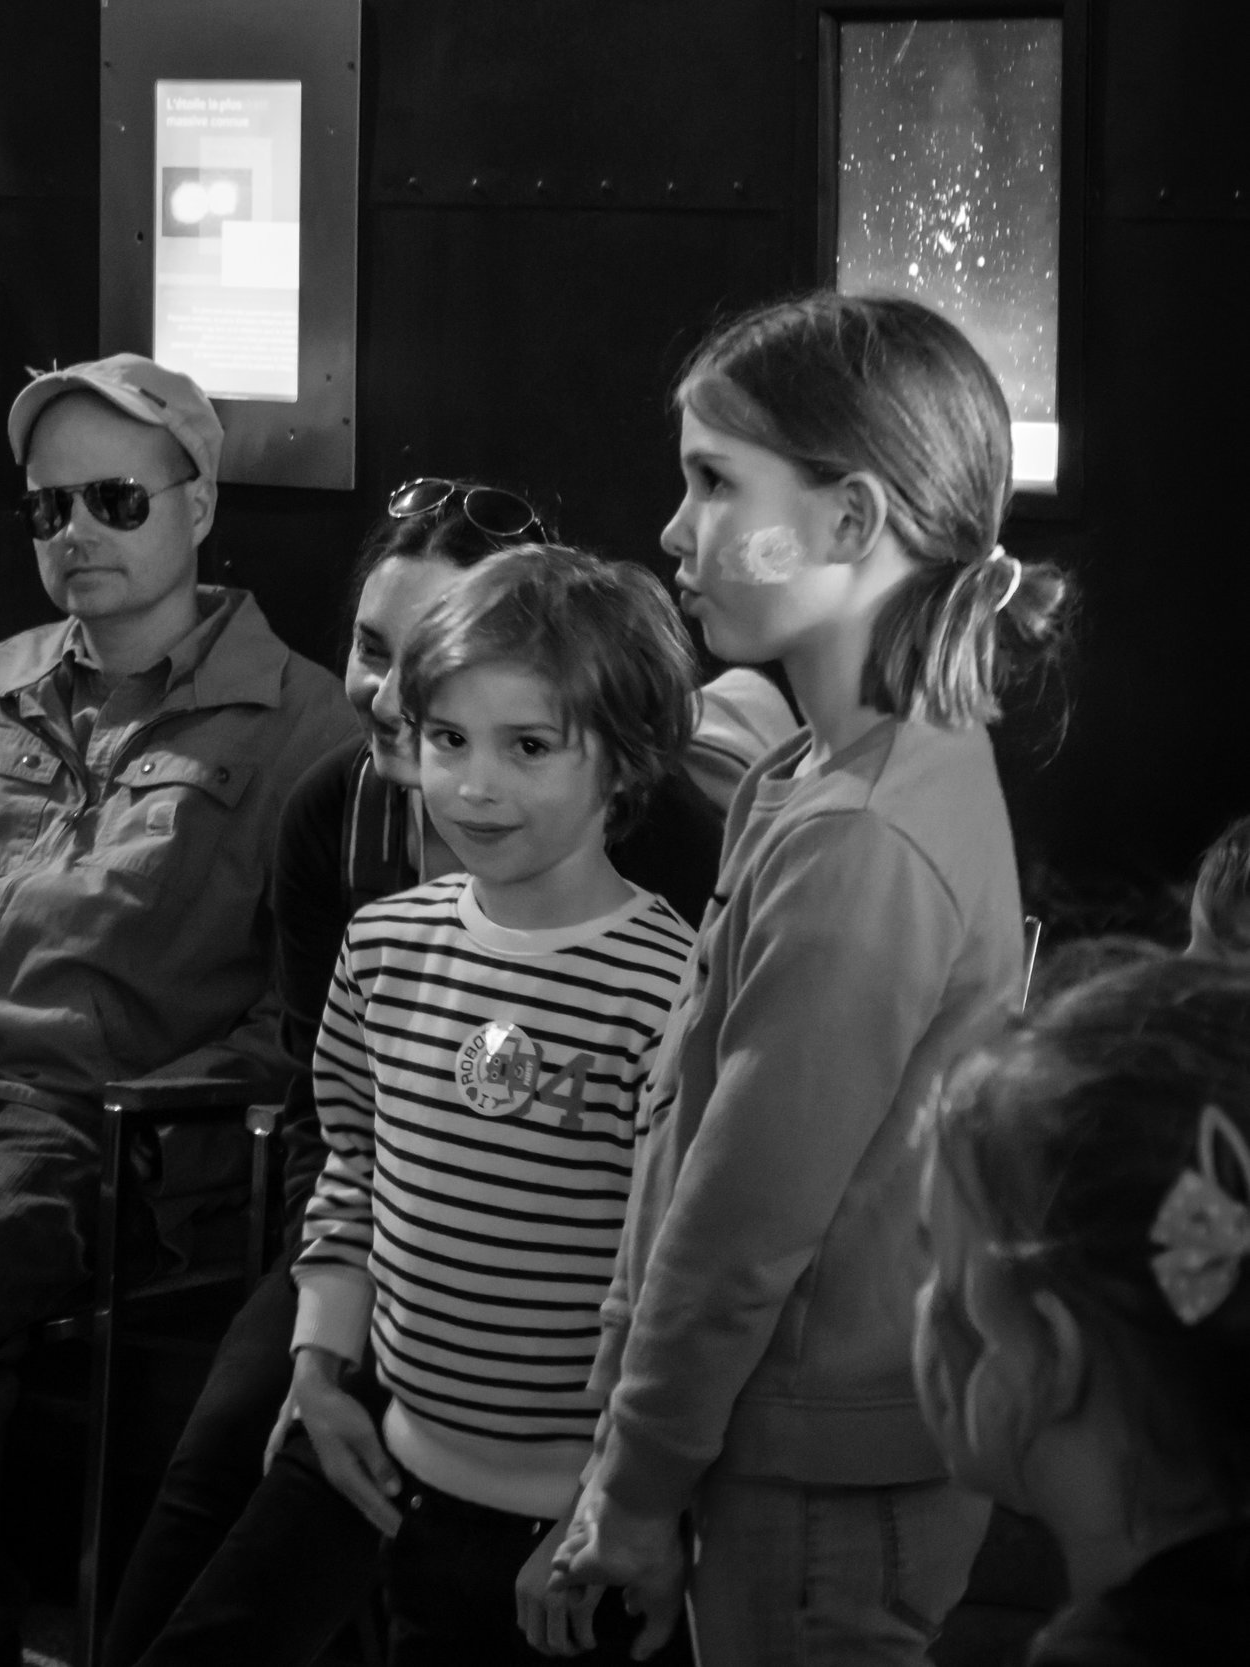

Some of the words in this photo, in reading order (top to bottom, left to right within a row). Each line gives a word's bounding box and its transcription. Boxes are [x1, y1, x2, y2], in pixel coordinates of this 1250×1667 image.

[219, 97, 242, 113] plus
[166, 115, 207, 128] massive
[478, 1093, 489, 1109] I
